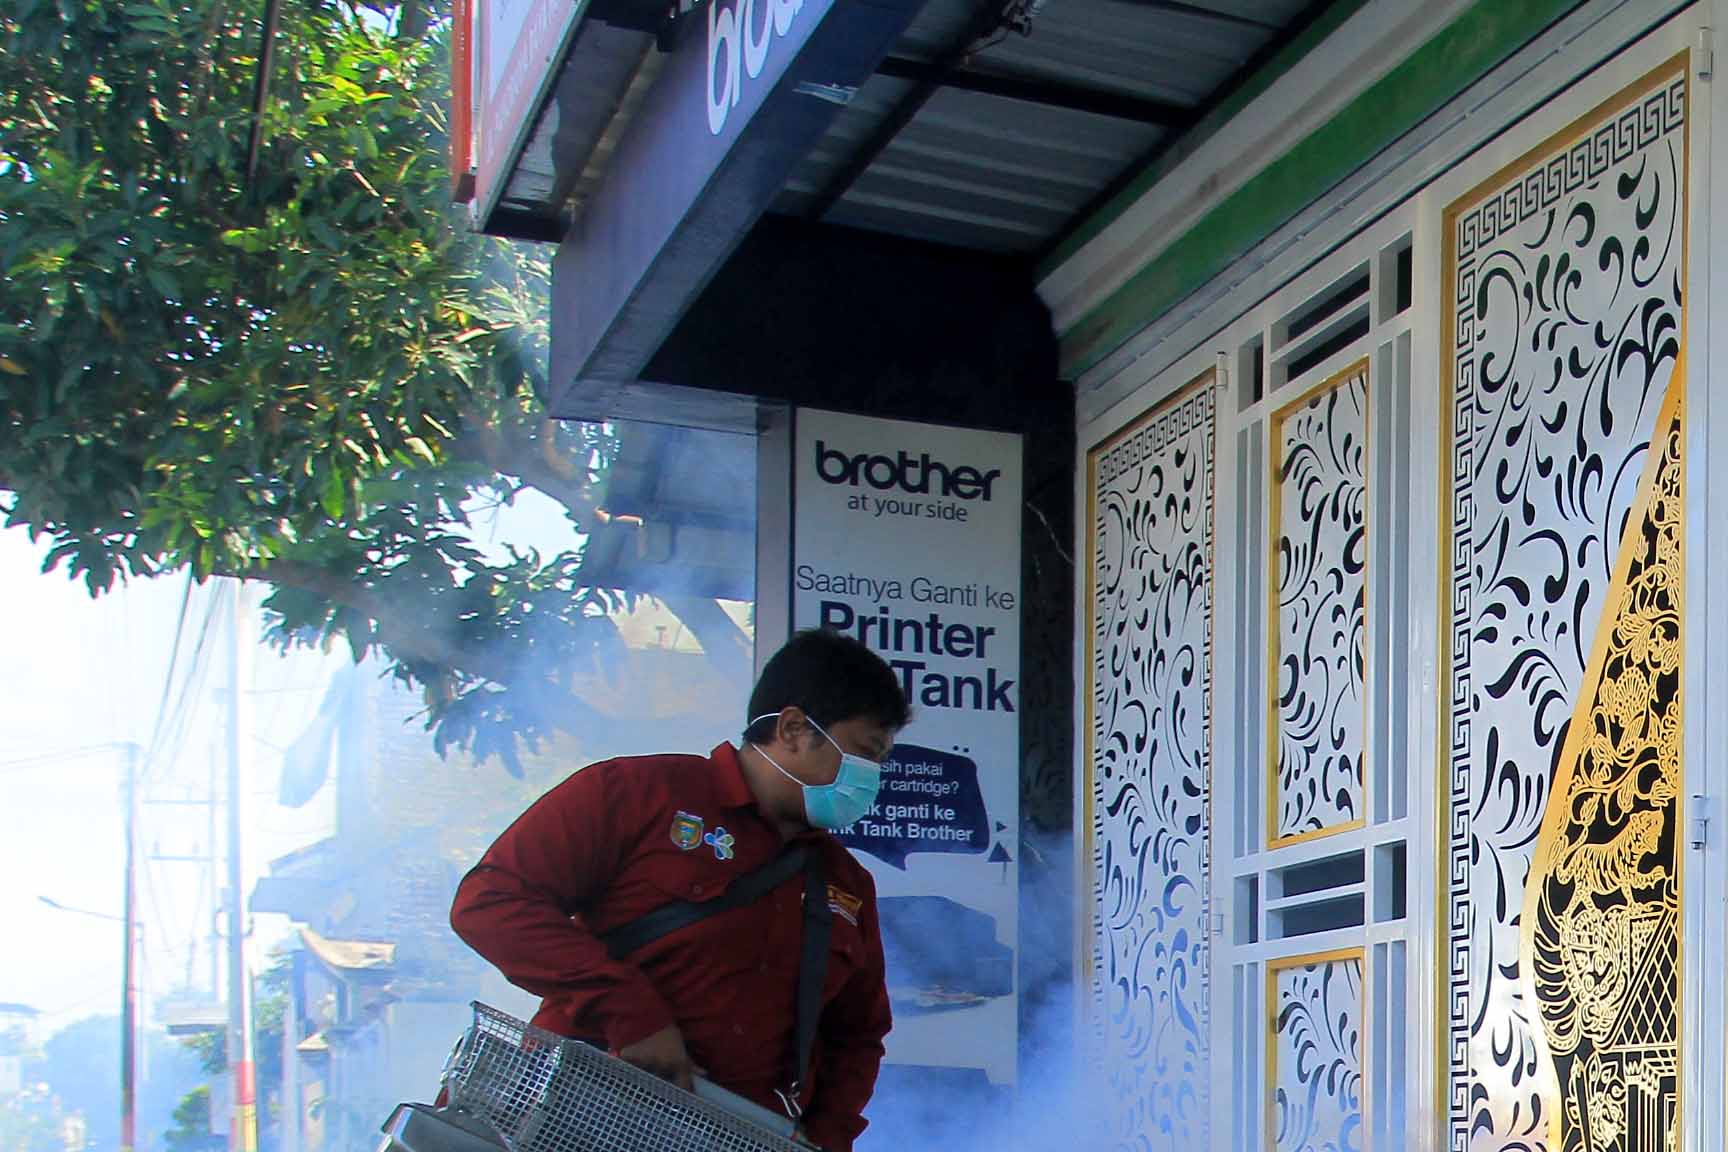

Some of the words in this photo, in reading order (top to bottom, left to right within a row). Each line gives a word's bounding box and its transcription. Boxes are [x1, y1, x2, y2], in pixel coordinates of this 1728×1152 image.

[707, 0, 803, 135] bro
[815, 440, 1002, 501] brother
[847, 494, 869, 511] at
[873, 499, 924, 518] your
[925, 500, 969, 522] side
[796, 565, 903, 603] Saatnya
[910, 577, 977, 607] Ganti
[985, 585, 1015, 610] ke
[820, 600, 996, 659] Printer
[890, 659, 1016, 713] Tank
[880, 760, 902, 773] sih
[905, 761, 944, 776] pakai
[890, 779, 960, 797] cartridge?
[859, 820, 903, 838] Tank
[907, 823, 975, 841] Brother
[885, 804, 930, 821] ganti
[934, 804, 956, 820] ke
